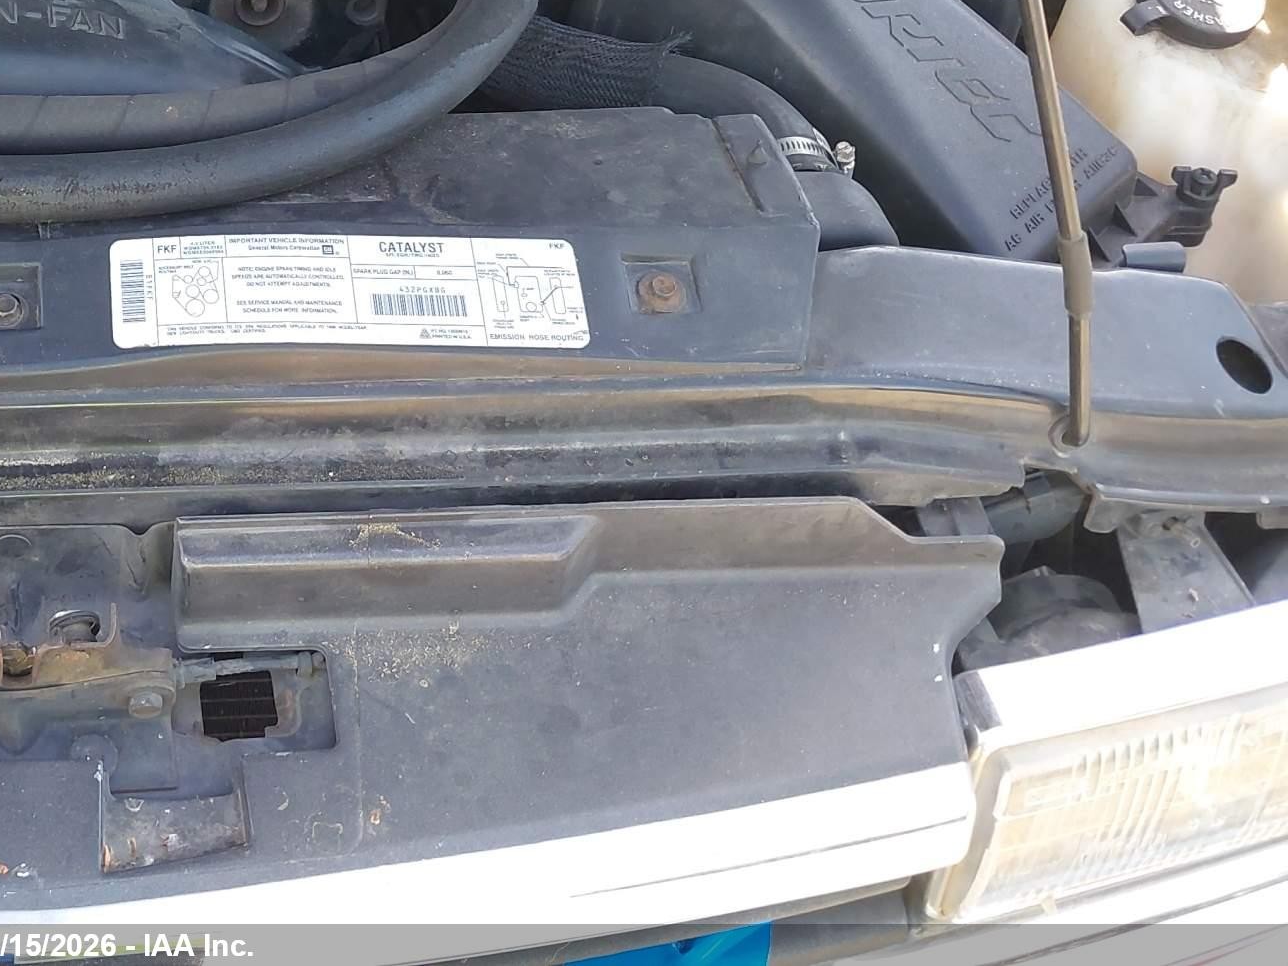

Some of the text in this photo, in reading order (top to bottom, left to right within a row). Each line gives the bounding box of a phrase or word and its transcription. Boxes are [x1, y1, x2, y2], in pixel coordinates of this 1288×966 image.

[298, 237, 345, 245] INFORMATION
[157, 245, 177, 254] FKF
[378, 241, 445, 253] CATALYST
